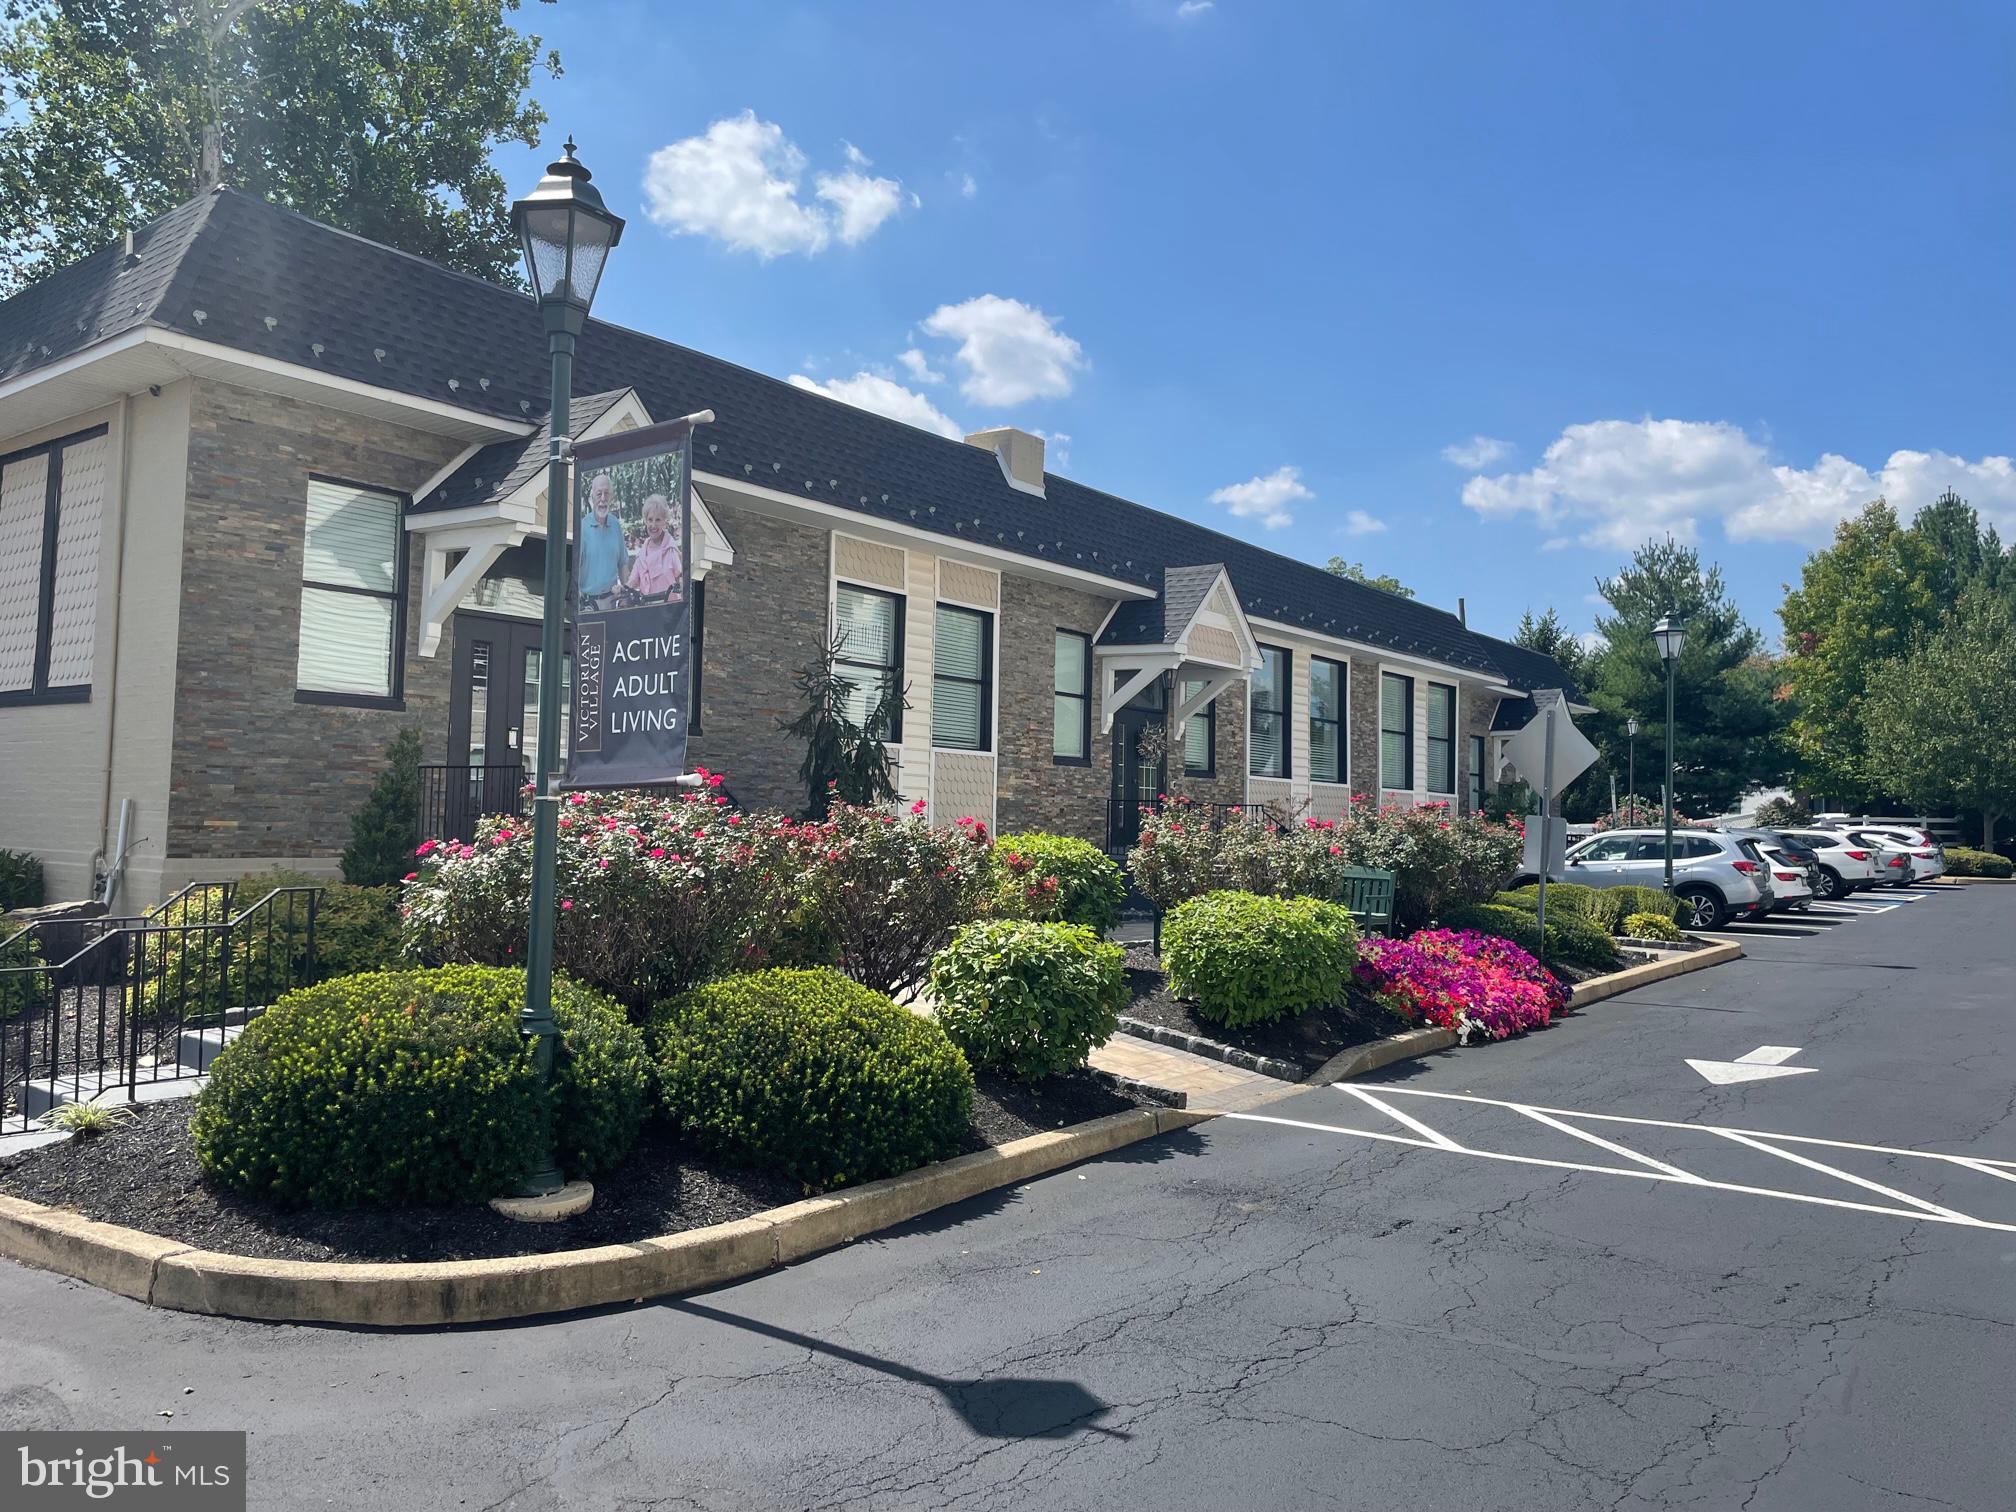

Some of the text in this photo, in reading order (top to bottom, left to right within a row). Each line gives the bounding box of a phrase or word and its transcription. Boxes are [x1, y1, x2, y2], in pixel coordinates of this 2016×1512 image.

[612, 634, 680, 663] ACTIVE
[579, 634, 590, 743] VICTORIAN
[589, 644, 601, 731] VILLAGE
[612, 671, 678, 698] ADULT
[611, 708, 677, 734] LIVING
